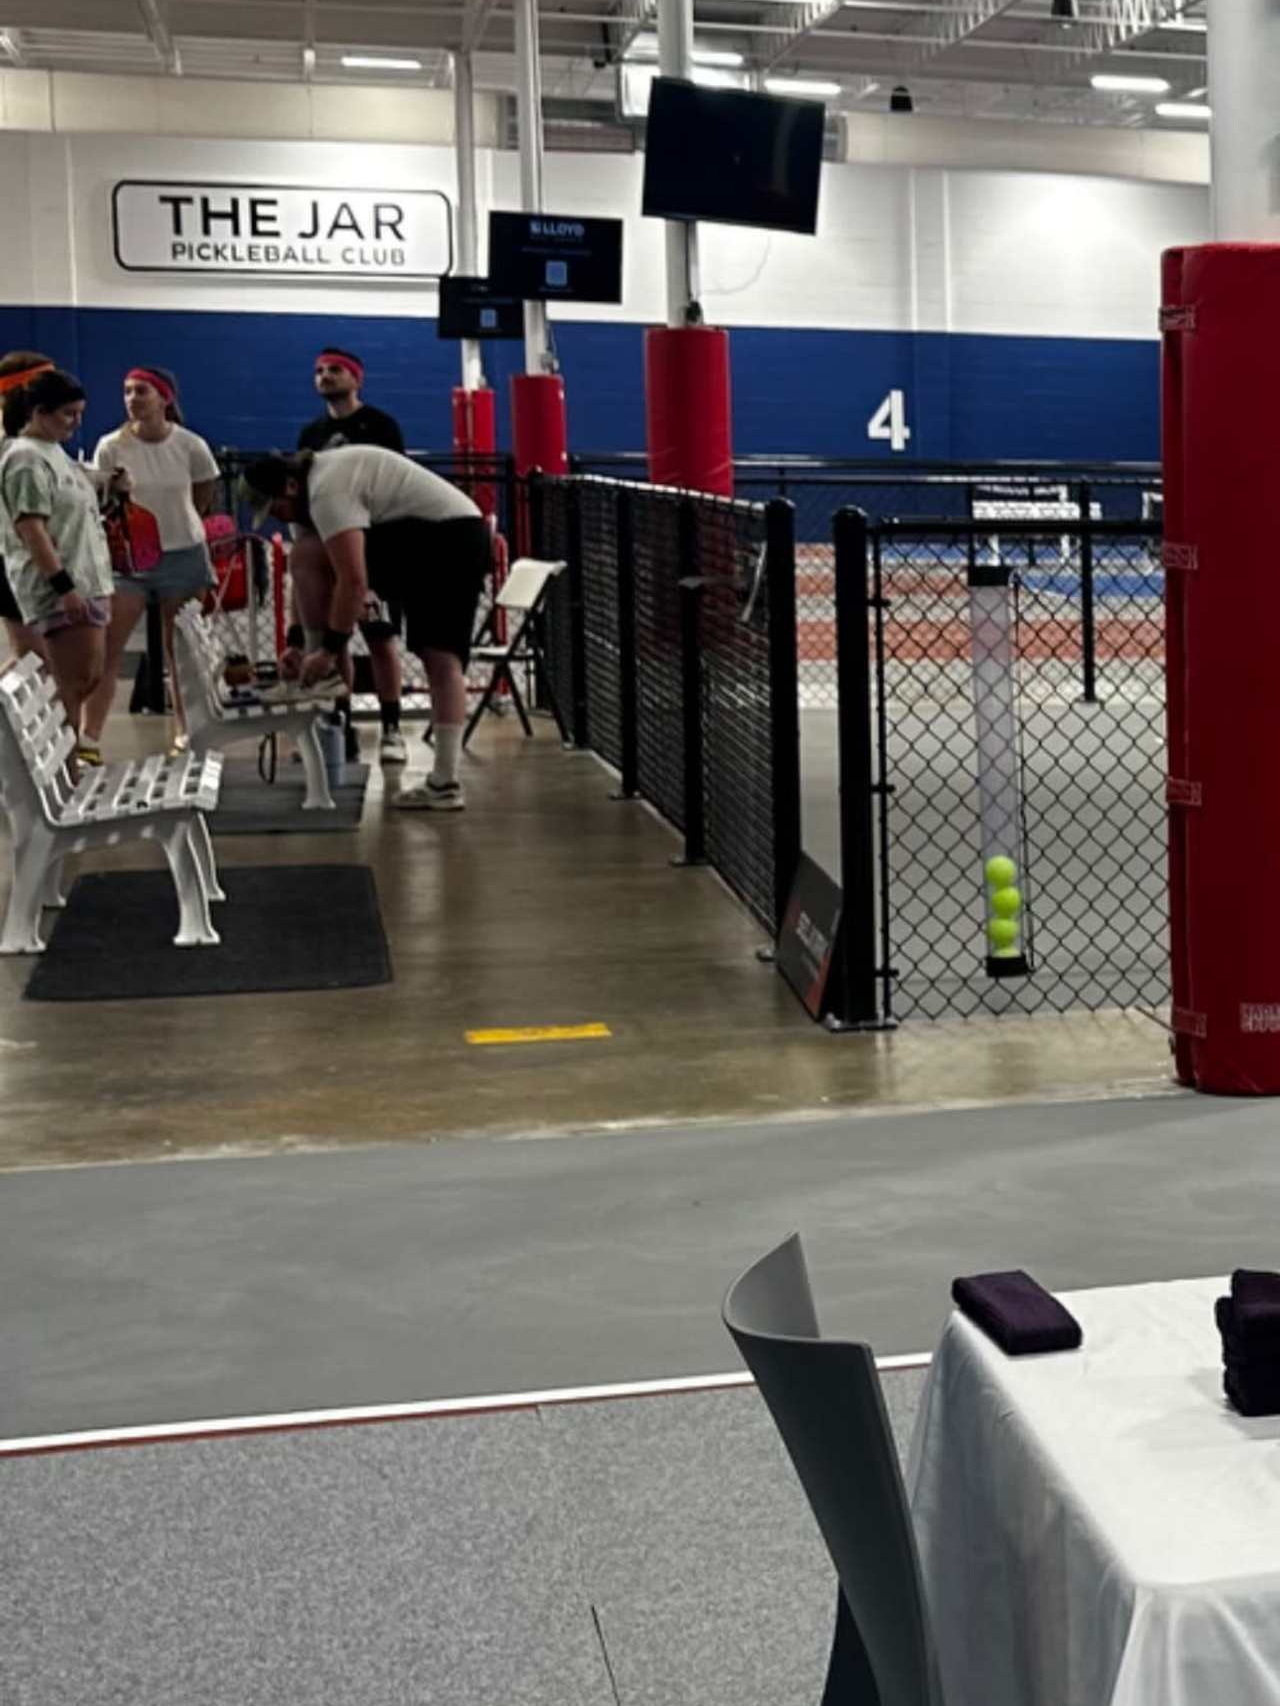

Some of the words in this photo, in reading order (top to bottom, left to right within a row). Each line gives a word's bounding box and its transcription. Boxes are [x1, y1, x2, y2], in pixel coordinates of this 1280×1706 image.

[159, 195, 280, 238] THE
[297, 200, 406, 241] JAR
[171, 241, 331, 264] PICKLEBALL
[341, 247, 406, 266] CLUB
[867, 389, 911, 451] 4
